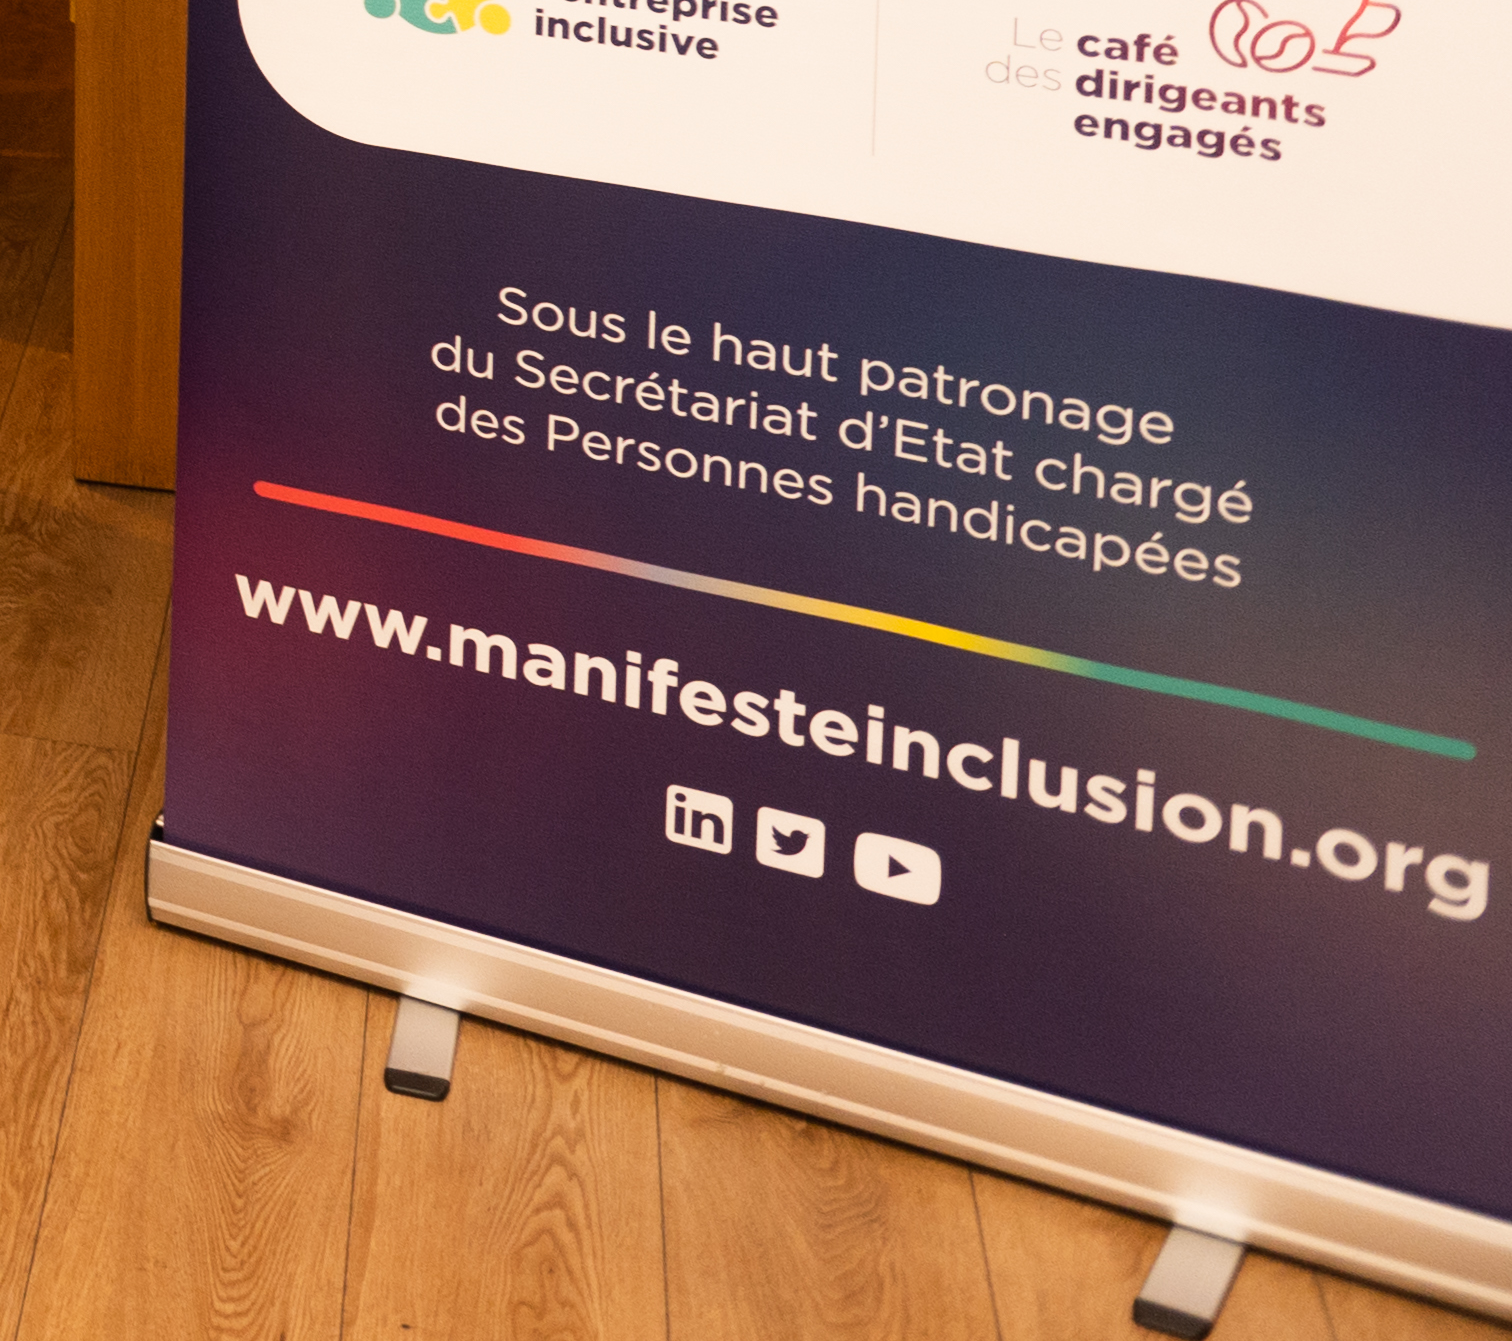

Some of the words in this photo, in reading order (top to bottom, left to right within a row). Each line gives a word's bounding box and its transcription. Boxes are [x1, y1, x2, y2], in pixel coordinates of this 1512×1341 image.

[534, 7, 720, 61] inclusive
[985, 54, 1063, 92] des
[1075, 68, 1326, 128] dirigeants
[1012, 16, 1064, 52] Le
[1076, 33, 1179, 66] café
[1073, 114, 1282, 162] engagés
[497, 286, 626, 343] Sous
[648, 310, 691, 356] le
[713, 322, 839, 382] haut
[860, 358, 1174, 446] patronage
[431, 335, 494, 380] du
[514, 346, 819, 441] Secrétariat
[838, 411, 1013, 481] d'Etat
[1035, 452, 1253, 524] chargé
[436, 395, 525, 445] des
[547, 415, 835, 506] Personnes
[855, 471, 1244, 589] handicapées
[234, 571, 1490, 922] www.manifesteinclusion.org
